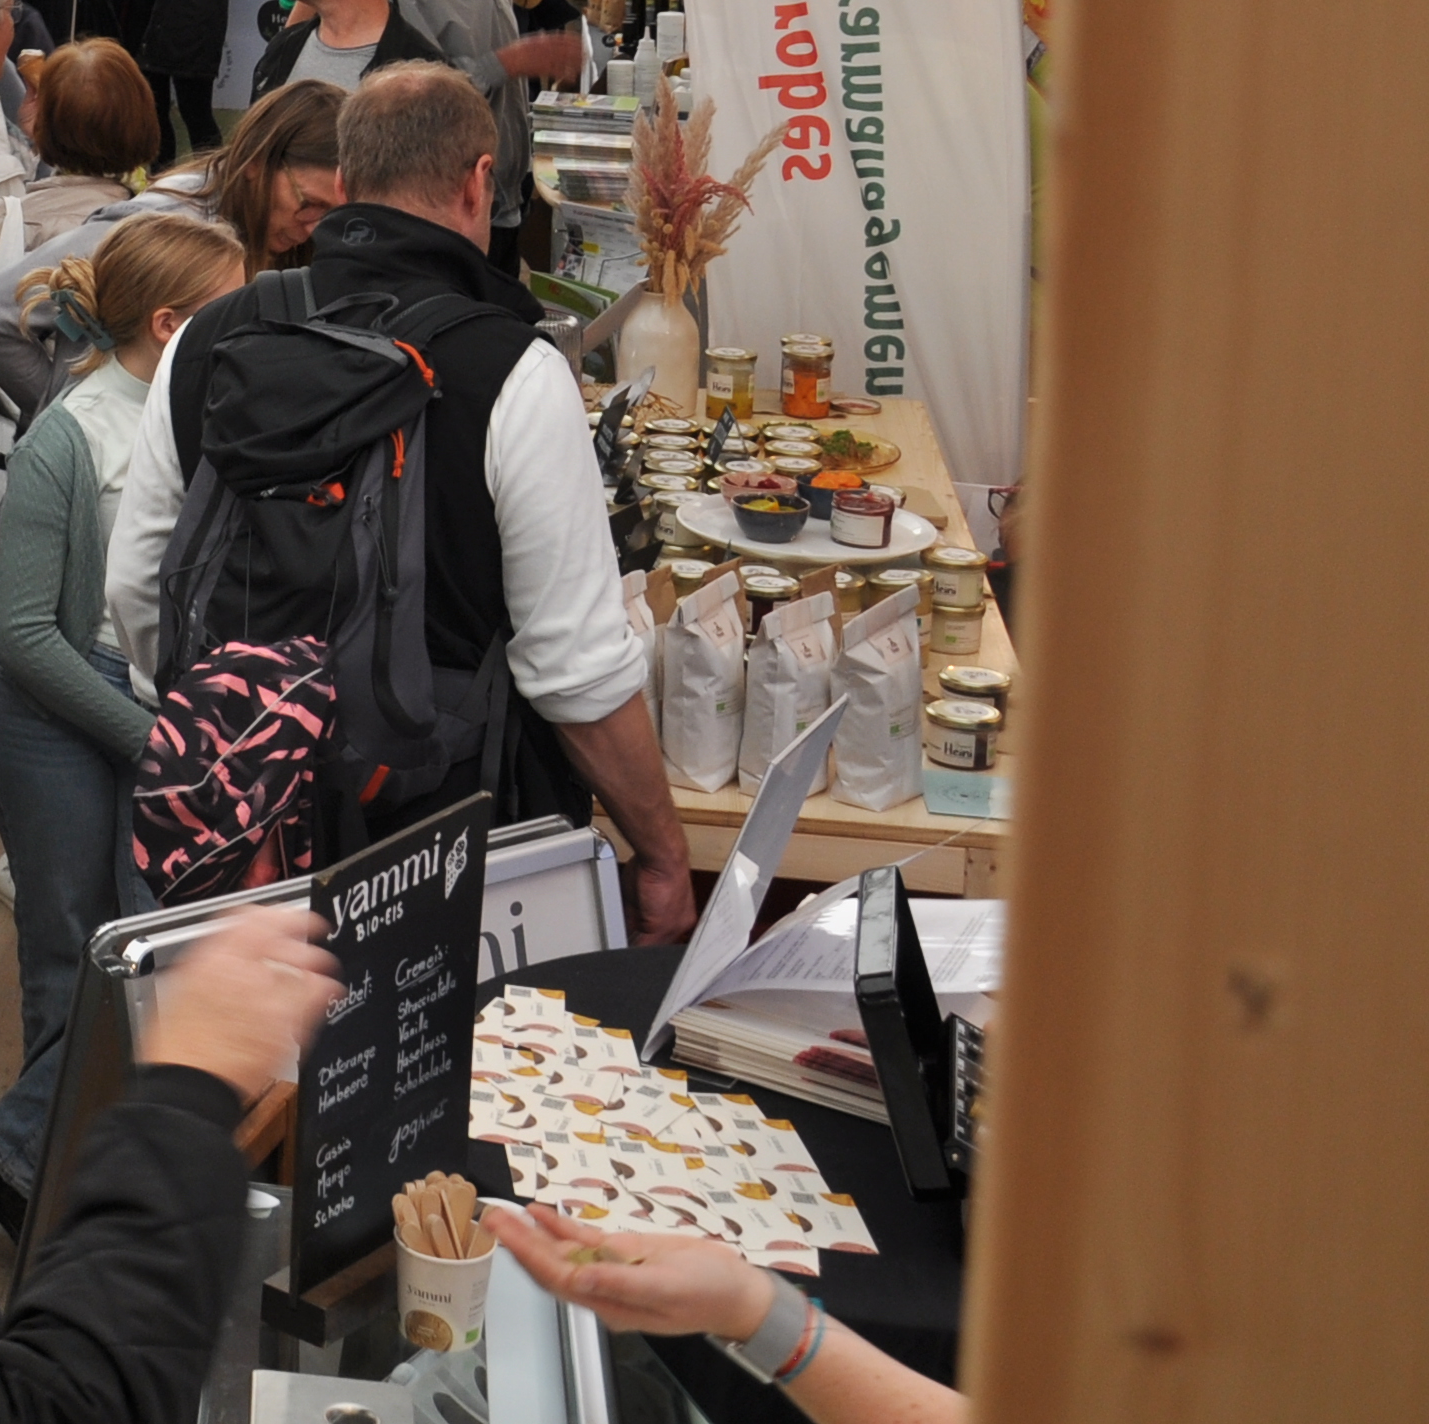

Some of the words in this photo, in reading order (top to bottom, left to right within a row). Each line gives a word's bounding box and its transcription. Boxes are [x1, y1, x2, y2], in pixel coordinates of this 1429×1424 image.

[944, 741, 973, 759] Heini
[327, 832, 442, 941] yammi
[397, 1033, 447, 1074] Haselnuss
[316, 1136, 352, 1168] Cassis
[317, 1164, 351, 1199] Mango
[314, 1195, 355, 1228] Schoko
